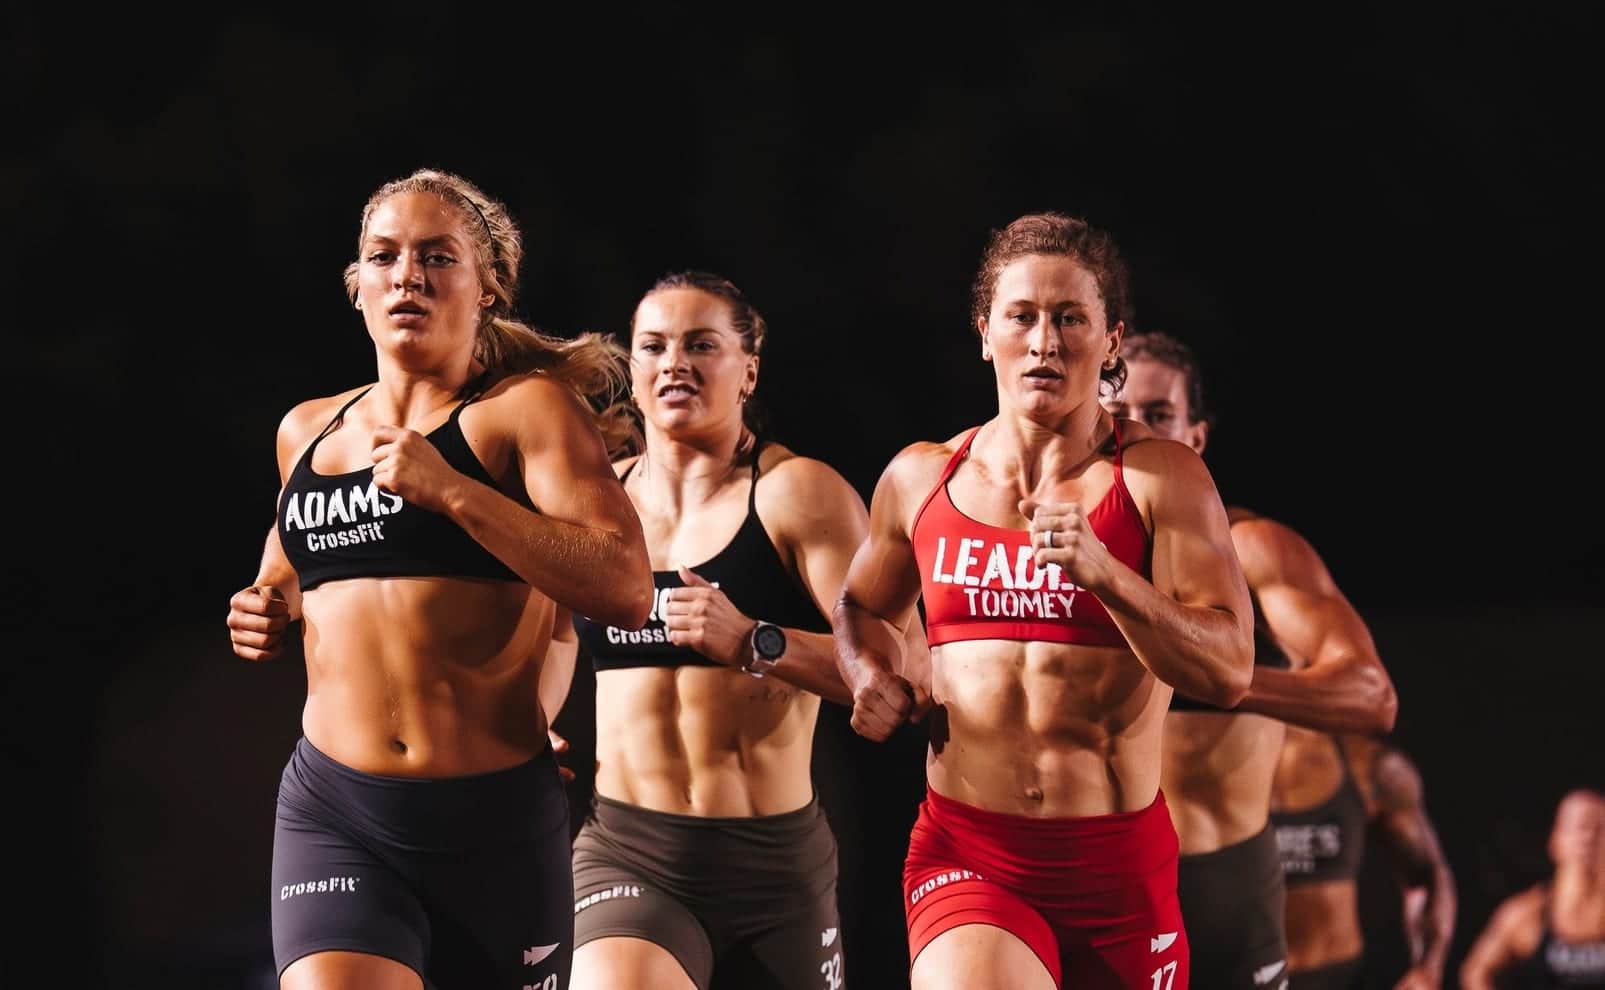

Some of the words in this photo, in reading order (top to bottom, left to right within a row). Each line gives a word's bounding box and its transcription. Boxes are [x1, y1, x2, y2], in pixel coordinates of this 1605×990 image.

[285, 481, 404, 532] ADAMS
[306, 521, 385, 552] CrossFit
[963, 588, 1076, 619] TOOMEY
[606, 625, 672, 644] Cross
[280, 877, 356, 901] CrossFit
[574, 885, 640, 914] rossFit
[911, 869, 983, 905] CrossF
[820, 952, 841, 990] 32
[1151, 960, 1178, 990] 17
